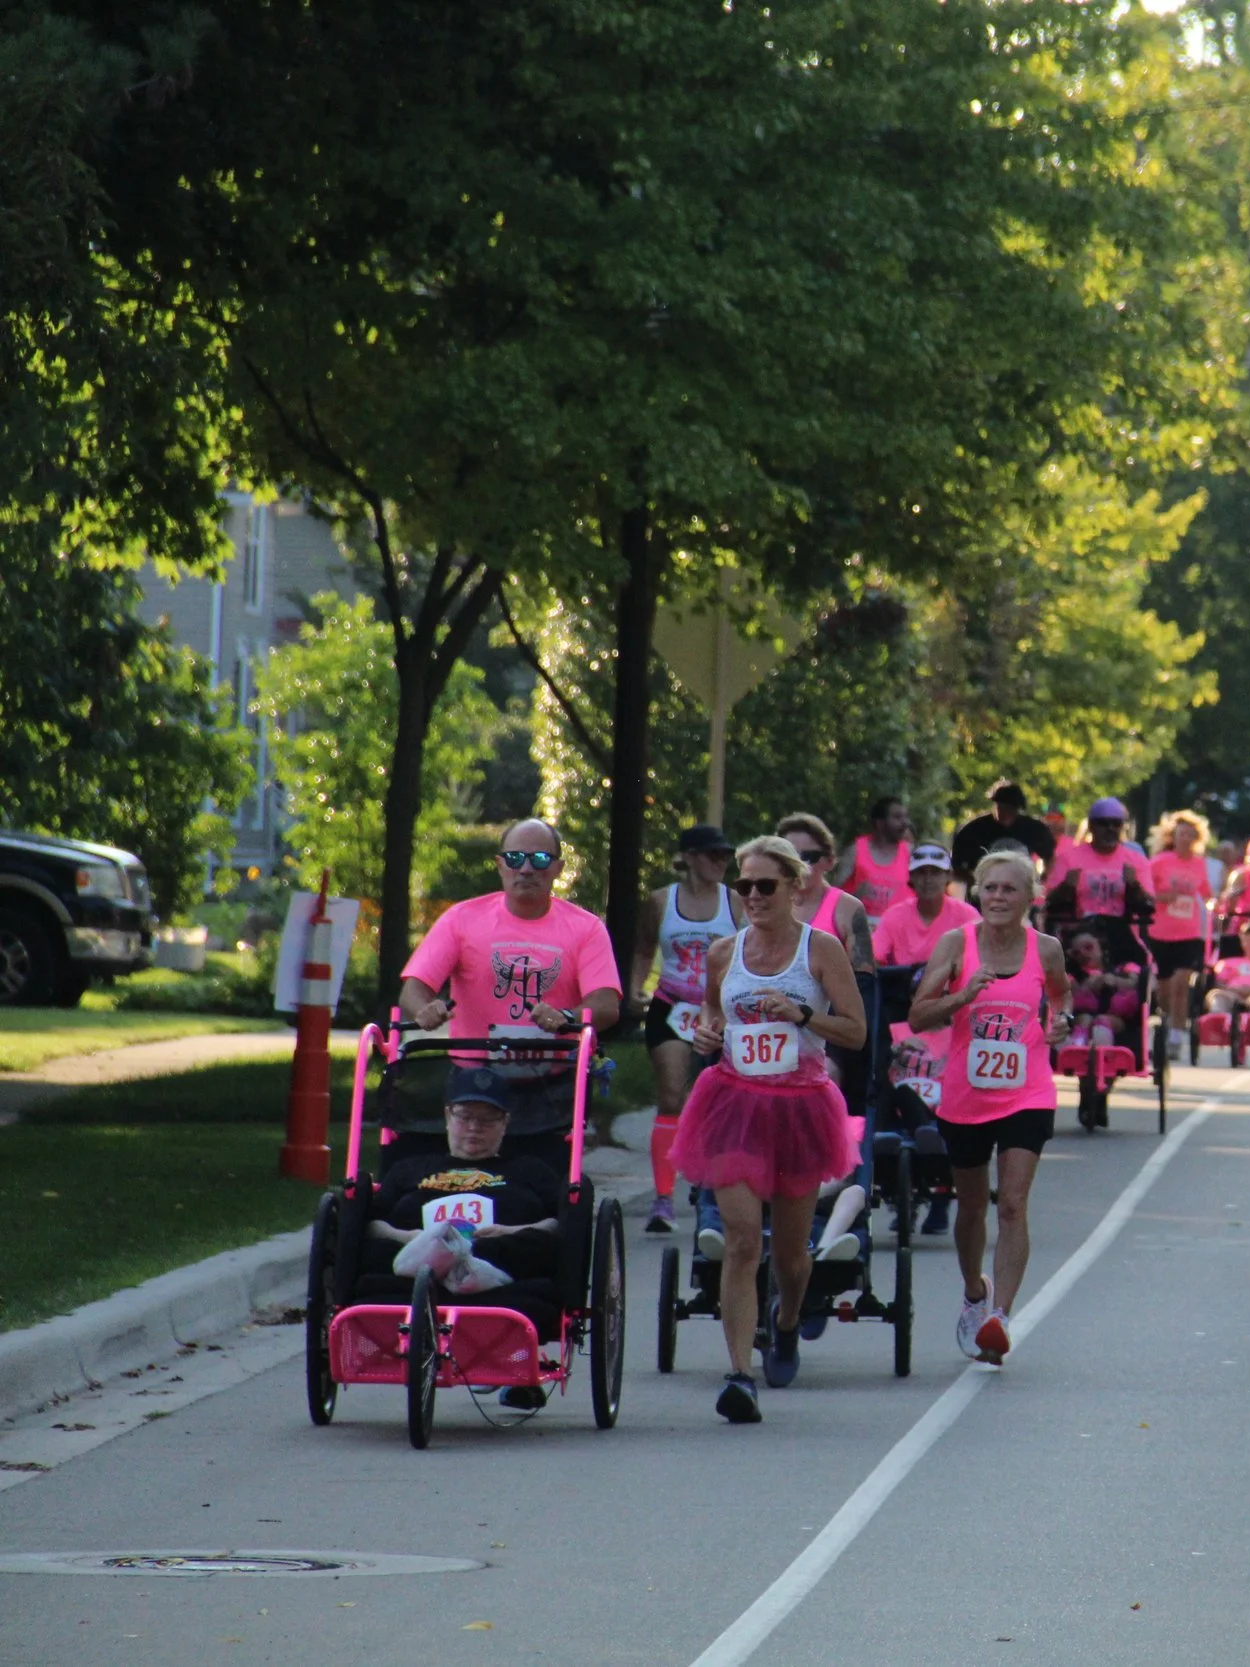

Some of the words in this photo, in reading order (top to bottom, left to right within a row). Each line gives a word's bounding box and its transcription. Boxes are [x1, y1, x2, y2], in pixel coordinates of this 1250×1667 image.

[741, 1033, 788, 1065] 367
[975, 1049, 1019, 1080] 229
[433, 1200, 484, 1225] 443
